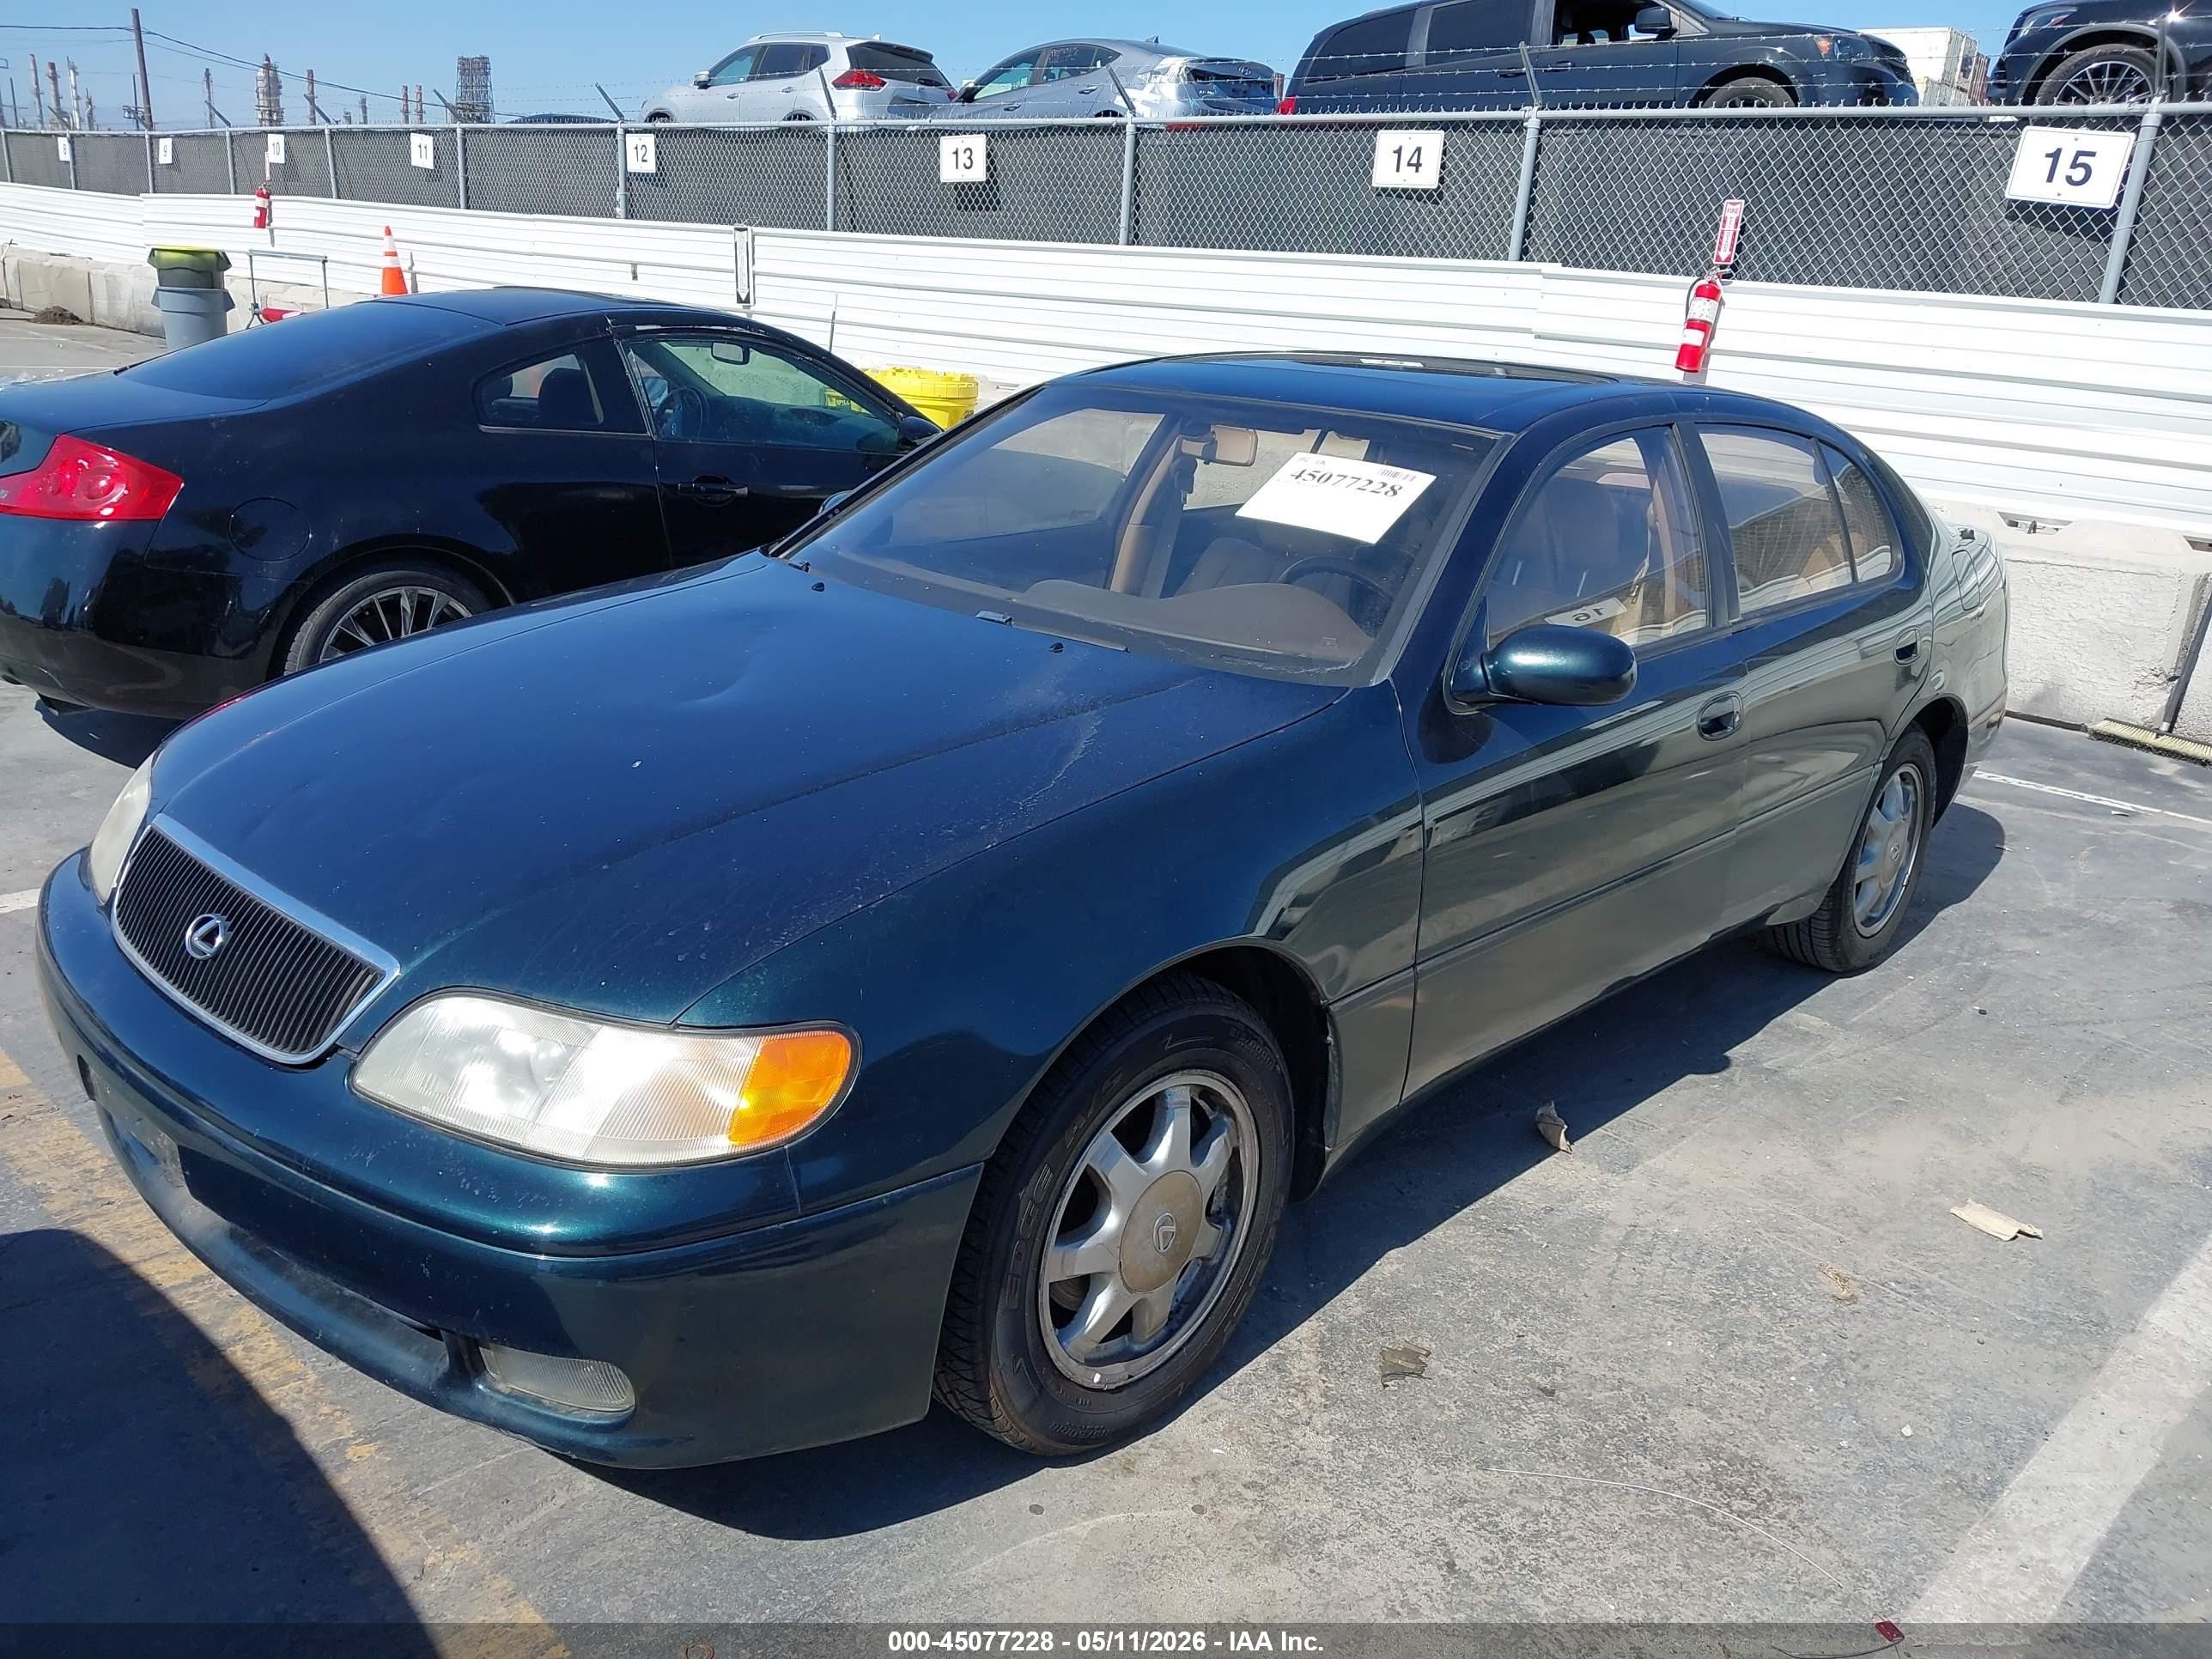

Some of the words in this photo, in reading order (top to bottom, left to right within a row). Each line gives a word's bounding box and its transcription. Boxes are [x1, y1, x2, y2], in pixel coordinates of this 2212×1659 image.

[162, 145, 168, 157] 9
[271, 142, 281, 155] 10
[418, 143, 428, 160] 11
[634, 144, 648, 162] 12
[951, 148, 974, 169] 13
[1391, 145, 1424, 173] 14
[2044, 147, 2096, 185] 15
[1291, 468, 1403, 498] 45077228
